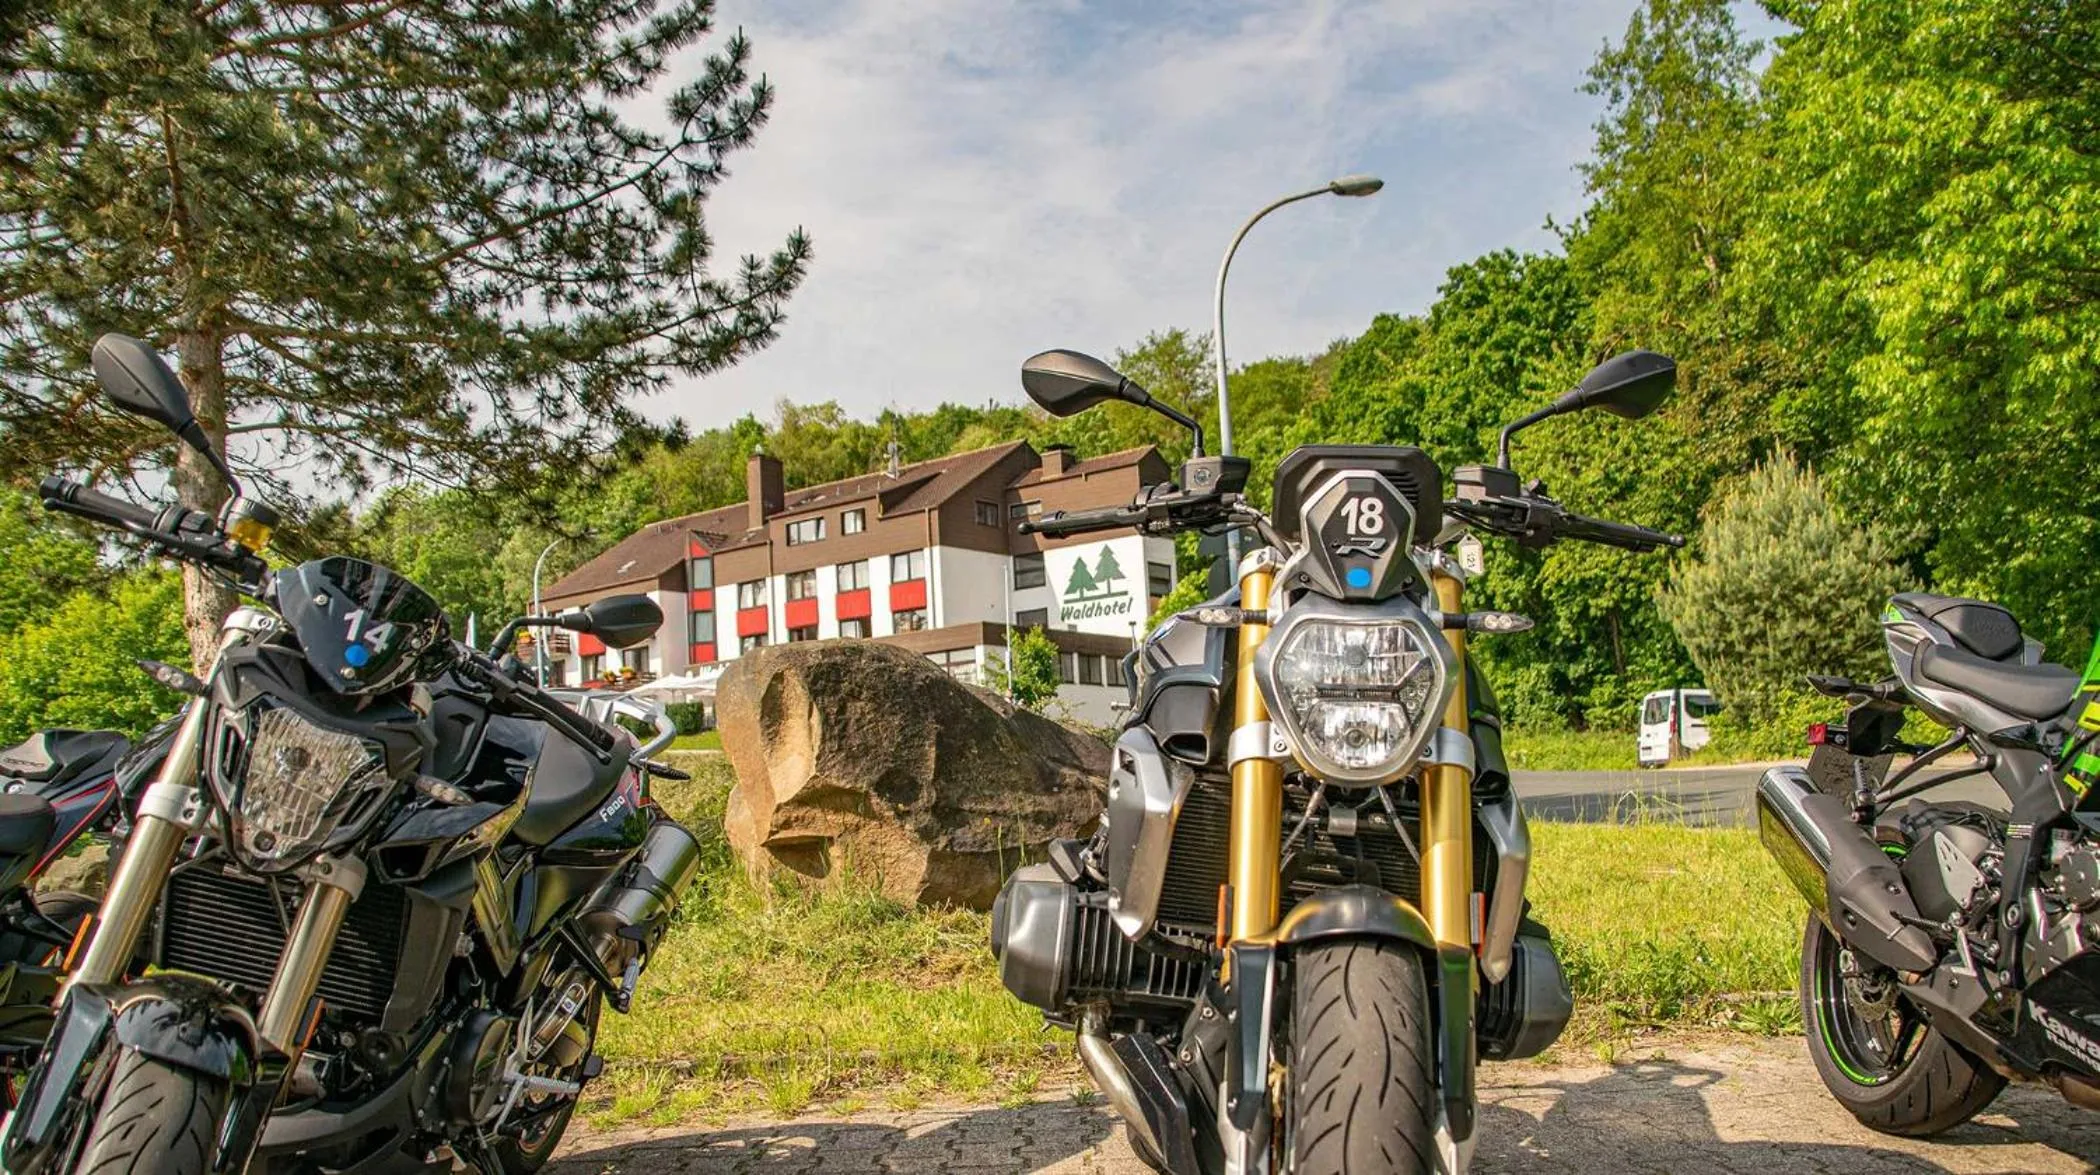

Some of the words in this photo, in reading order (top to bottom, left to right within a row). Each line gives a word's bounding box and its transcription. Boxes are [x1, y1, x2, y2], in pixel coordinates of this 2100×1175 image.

[1340, 496, 1384, 535] 18
[1061, 596, 1133, 622] Waldhotel
[343, 608, 394, 655] 14
